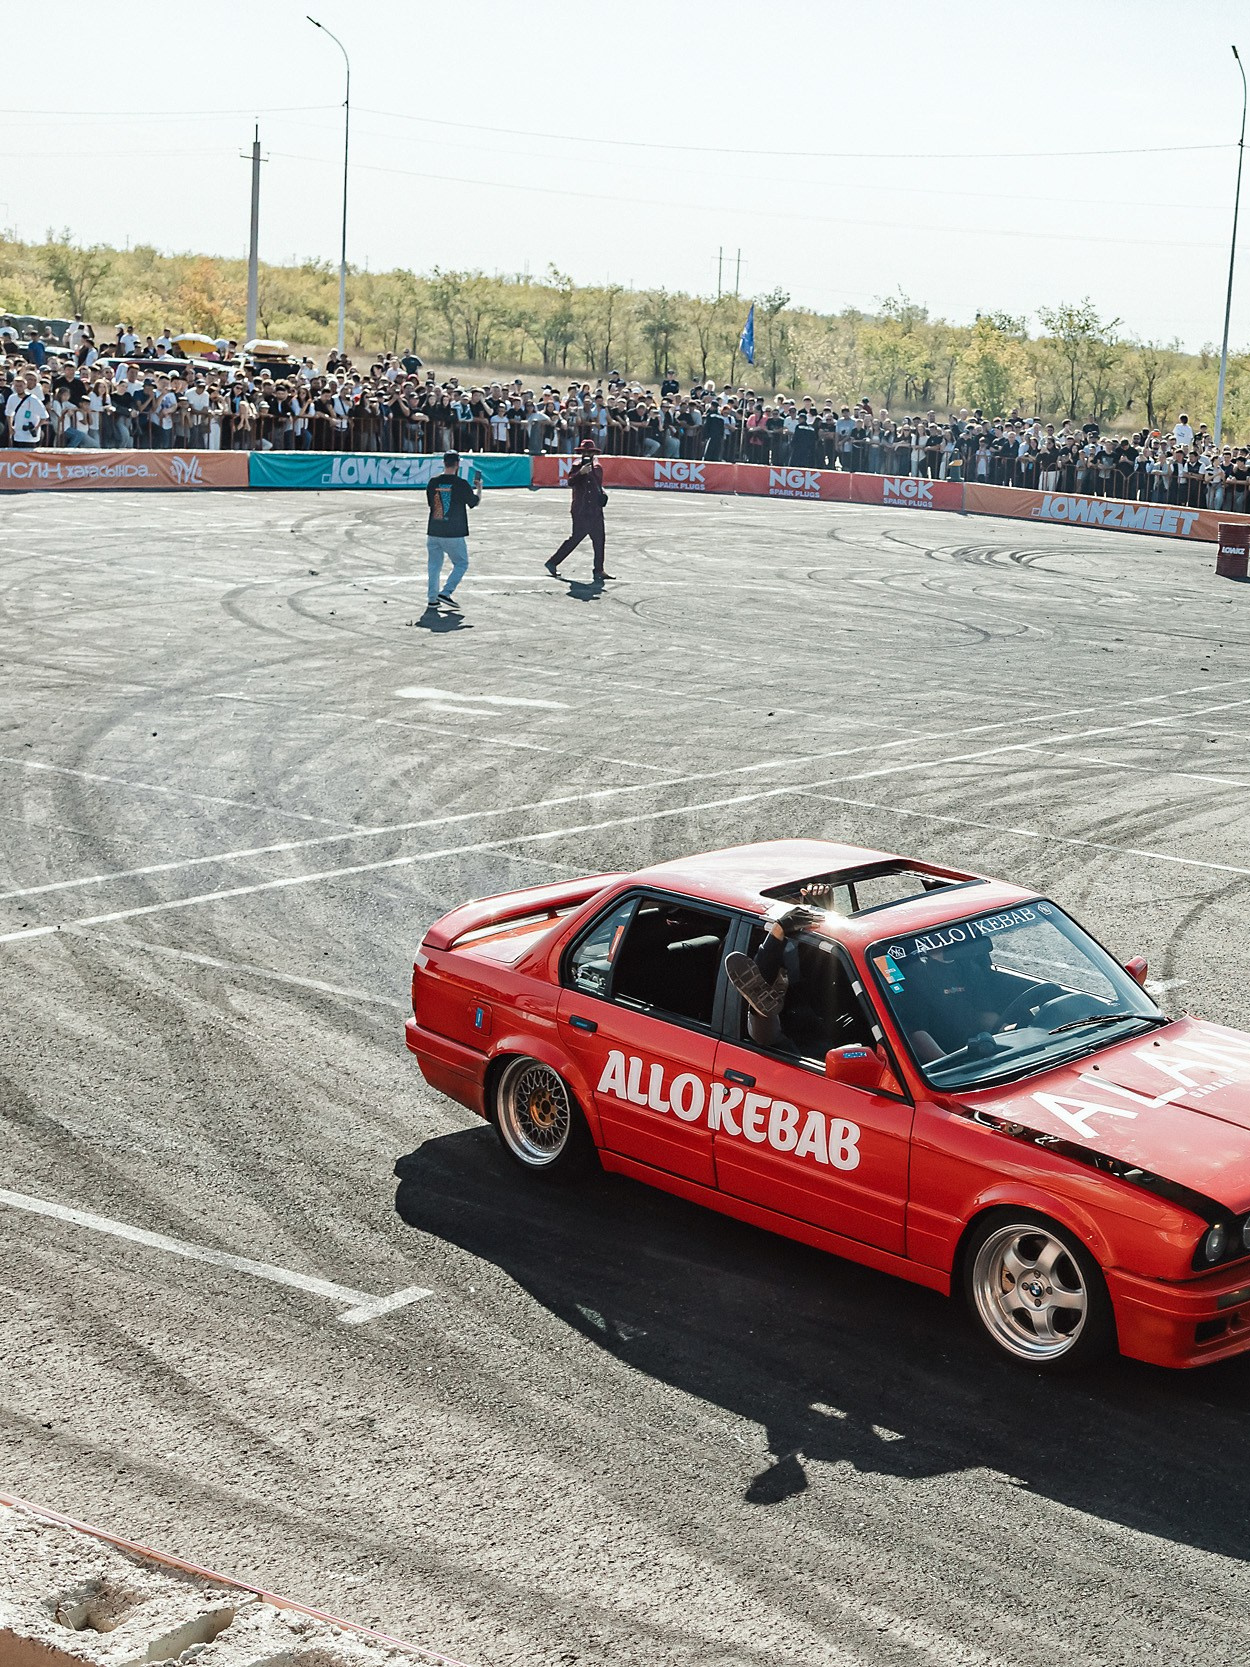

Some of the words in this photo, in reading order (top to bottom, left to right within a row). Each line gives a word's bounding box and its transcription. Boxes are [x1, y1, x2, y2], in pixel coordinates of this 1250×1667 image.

[331, 458, 473, 485] LOWKZMET
[654, 461, 706, 483] NGK
[769, 468, 821, 491] NGK
[655, 481, 679, 489] SPARK
[769, 488, 794, 496] SPARK
[795, 490, 820, 498] PLUGS
[883, 478, 934, 500] NGK
[883, 497, 907, 505] SPARK
[908, 499, 933, 508] PLUGS
[1040, 495, 1199, 535] LOWKZMEET
[1221, 546, 1245, 555] LOWKZ
[914, 928, 966, 954] ALLO
[974, 907, 1036, 935] KEBAB
[1188, 1077, 1239, 1098] GARAGE
